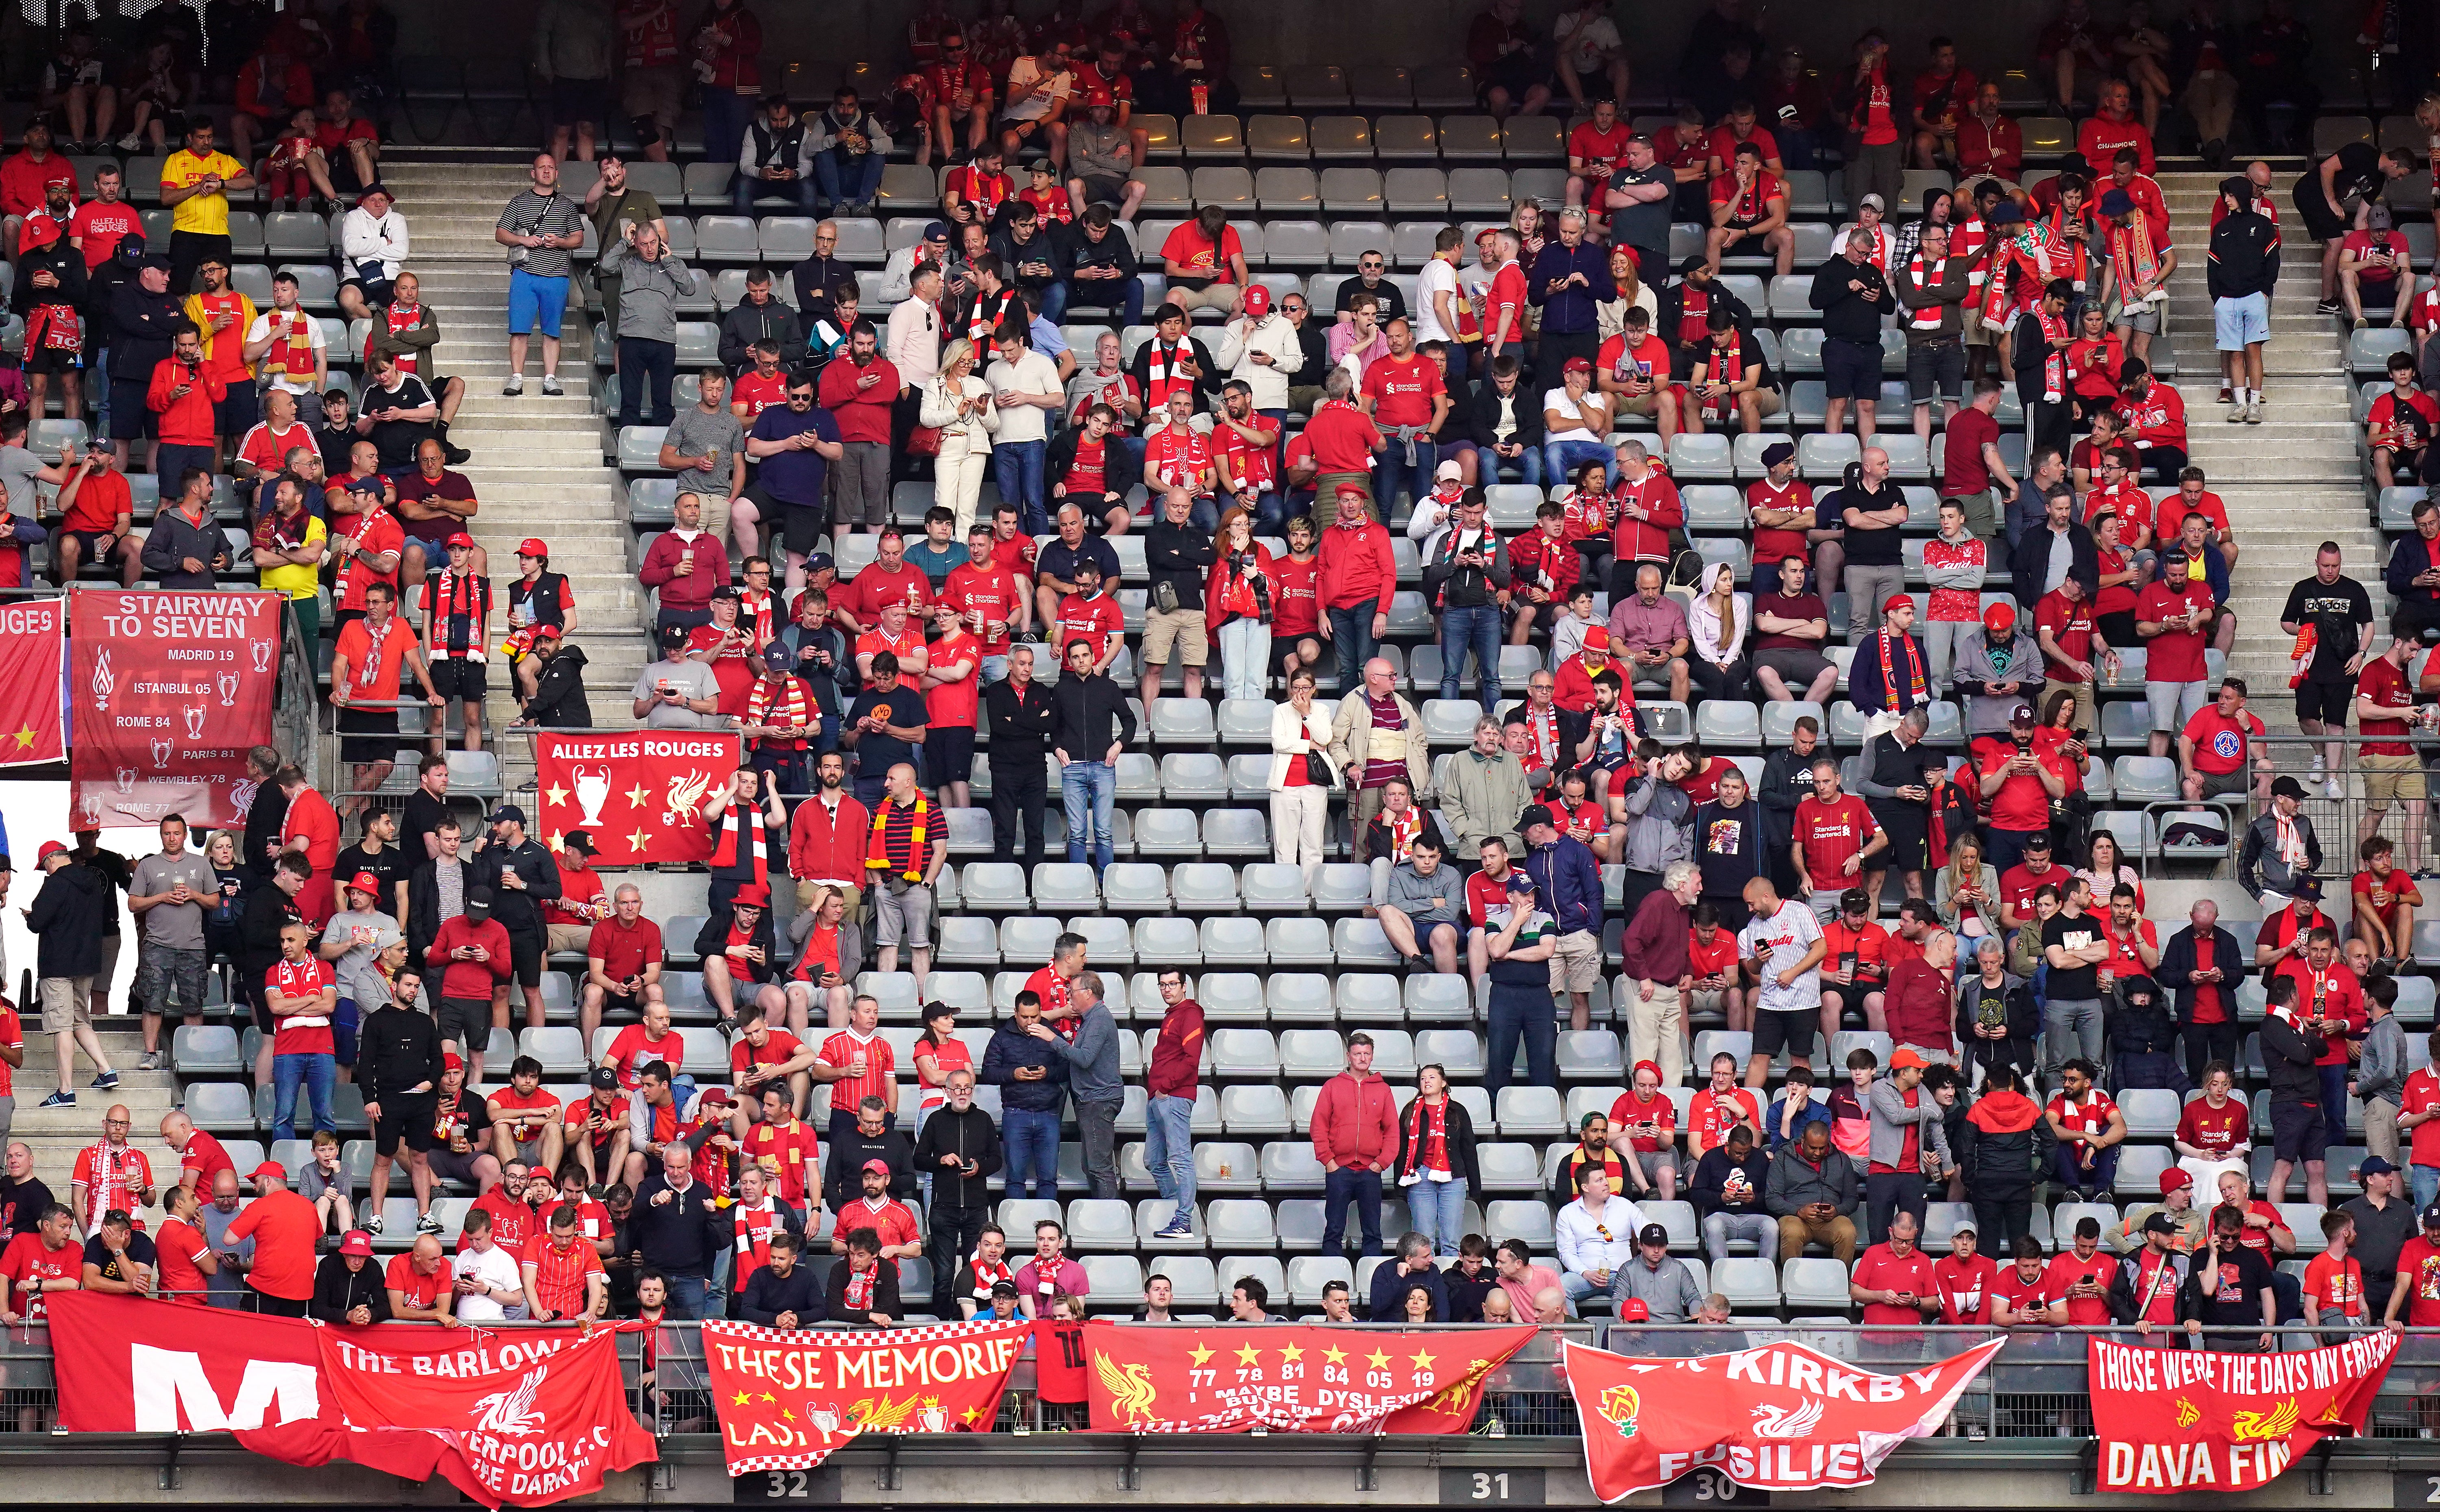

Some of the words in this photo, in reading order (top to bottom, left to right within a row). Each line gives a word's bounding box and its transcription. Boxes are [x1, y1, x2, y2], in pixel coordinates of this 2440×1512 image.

[91, 226, 128, 234] ROUGES
[120, 596, 266, 617] STAIRWAY
[103, 616, 141, 637] TO
[153, 616, 245, 638] SEVEN
[168, 649, 215, 661] MADRID
[219, 649, 234, 661] 19
[134, 682, 192, 694] ISTANBUL
[195, 682, 211, 694] 05
[116, 716, 152, 727] ROME
[155, 716, 171, 727] 84
[874, 706, 889, 718] VVD
[183, 750, 214, 759] PARIS
[216, 749, 235, 759] 81
[552, 743, 606, 759] ALLEZ
[610, 742, 640, 758] LES
[644, 740, 724, 758] ROUGES
[148, 774, 207, 785] WEMBLEY
[210, 774, 226, 784] 78
[116, 802, 150, 813] ROME
[154, 802, 170, 814] 77
[1947, 800, 1959, 809] AXA
[1765, 934, 1794, 947] andy
[32, 1259, 61, 1275] BOSS
[336, 1340, 402, 1374] THE
[412, 1338, 562, 1378] BARLOW
[715, 1343, 825, 1390] THESE
[2096, 1341, 2157, 1392] THOSE
[2161, 1351, 2217, 1389] WERE
[2220, 1355, 2257, 1395] THE
[2261, 1354, 2309, 1395] DAYS
[2312, 1347, 2339, 1390] MY
[1189, 1369, 1216, 1387] 77
[1235, 1368, 1264, 1382] 78
[1281, 1363, 1305, 1380] 81
[1323, 1365, 1349, 1386] 84
[1366, 1371, 1393, 1389] 05
[1411, 1371, 1435, 1388] 19
[1726, 1349, 1945, 1404] KIRKBY
[1190, 1392, 1196, 1403] I
[1215, 1385, 1299, 1403] MAYBE
[460, 1430, 569, 1471] ERPOOL
[1659, 1443, 1867, 1482] FUSILIE
[2107, 1441, 2216, 1487] DAVA
[2229, 1436, 2292, 1486] FIN
[767, 1471, 808, 1497] 32
[1471, 1473, 1510, 1499] 31
[1696, 1473, 1737, 1500] 30
[2426, 1477, 2440, 1502] 2
